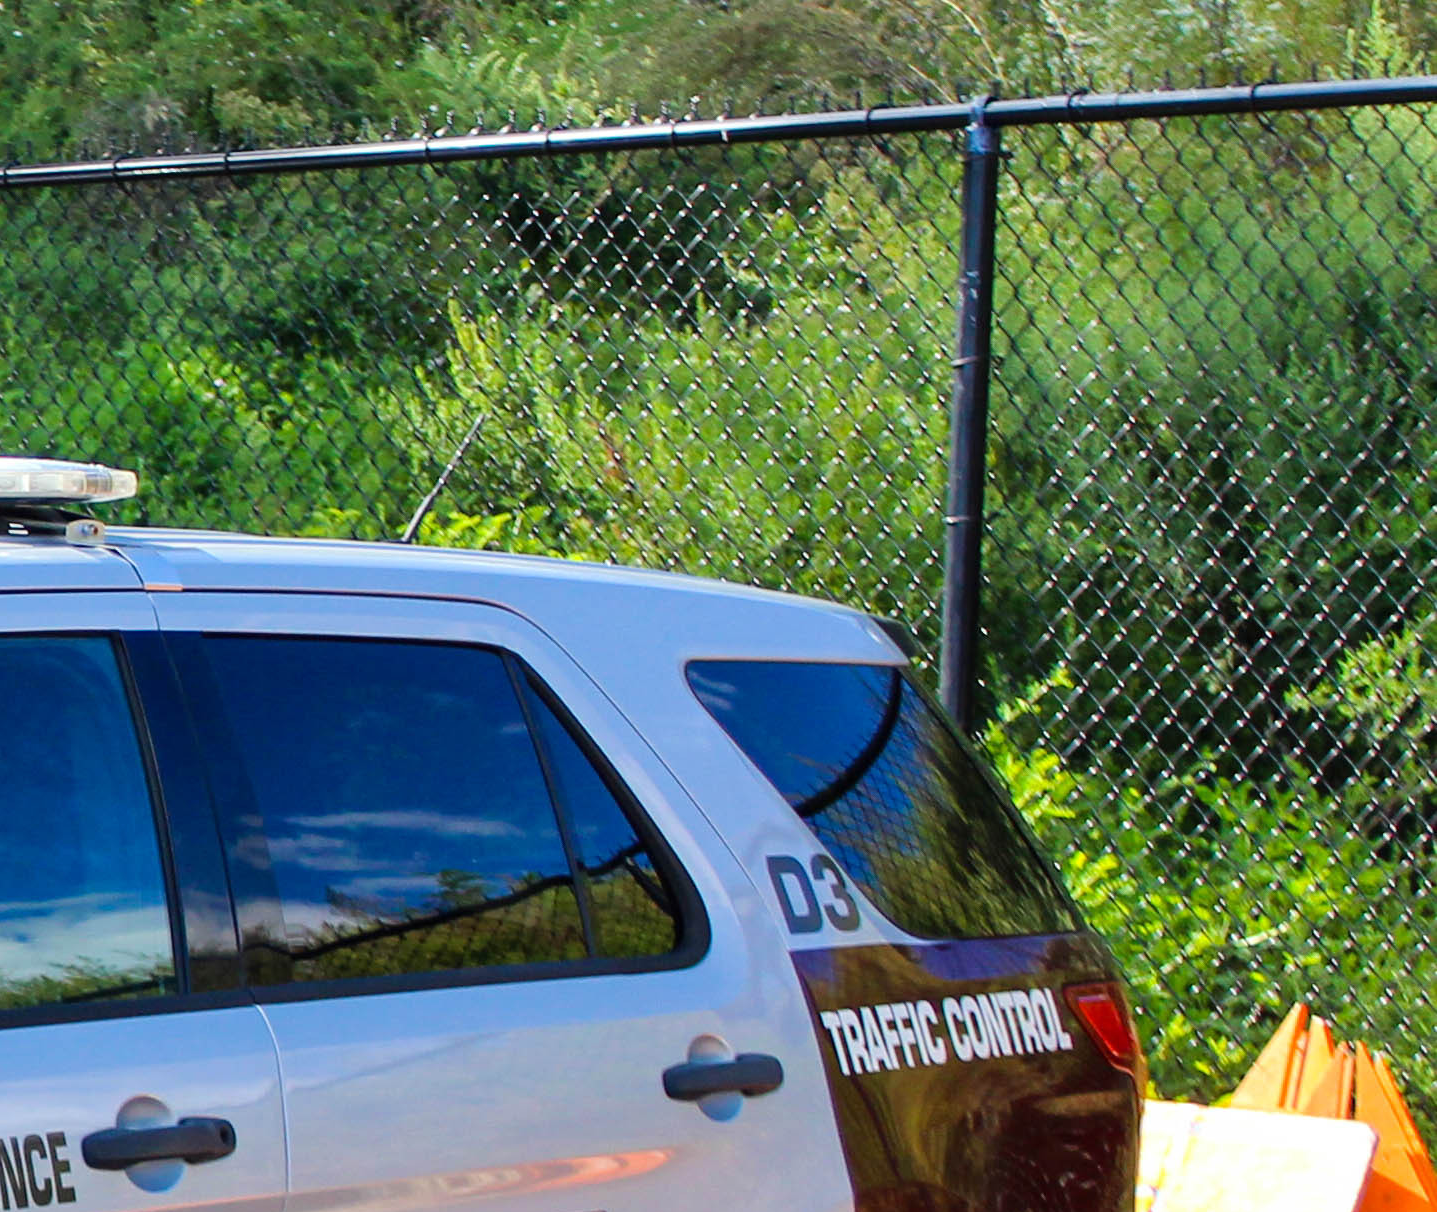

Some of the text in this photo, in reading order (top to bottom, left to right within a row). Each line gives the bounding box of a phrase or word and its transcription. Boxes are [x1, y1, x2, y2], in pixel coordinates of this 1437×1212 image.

[766, 853, 861, 934] D3
[820, 987, 1074, 1076] TRAFFIC CONTROL
